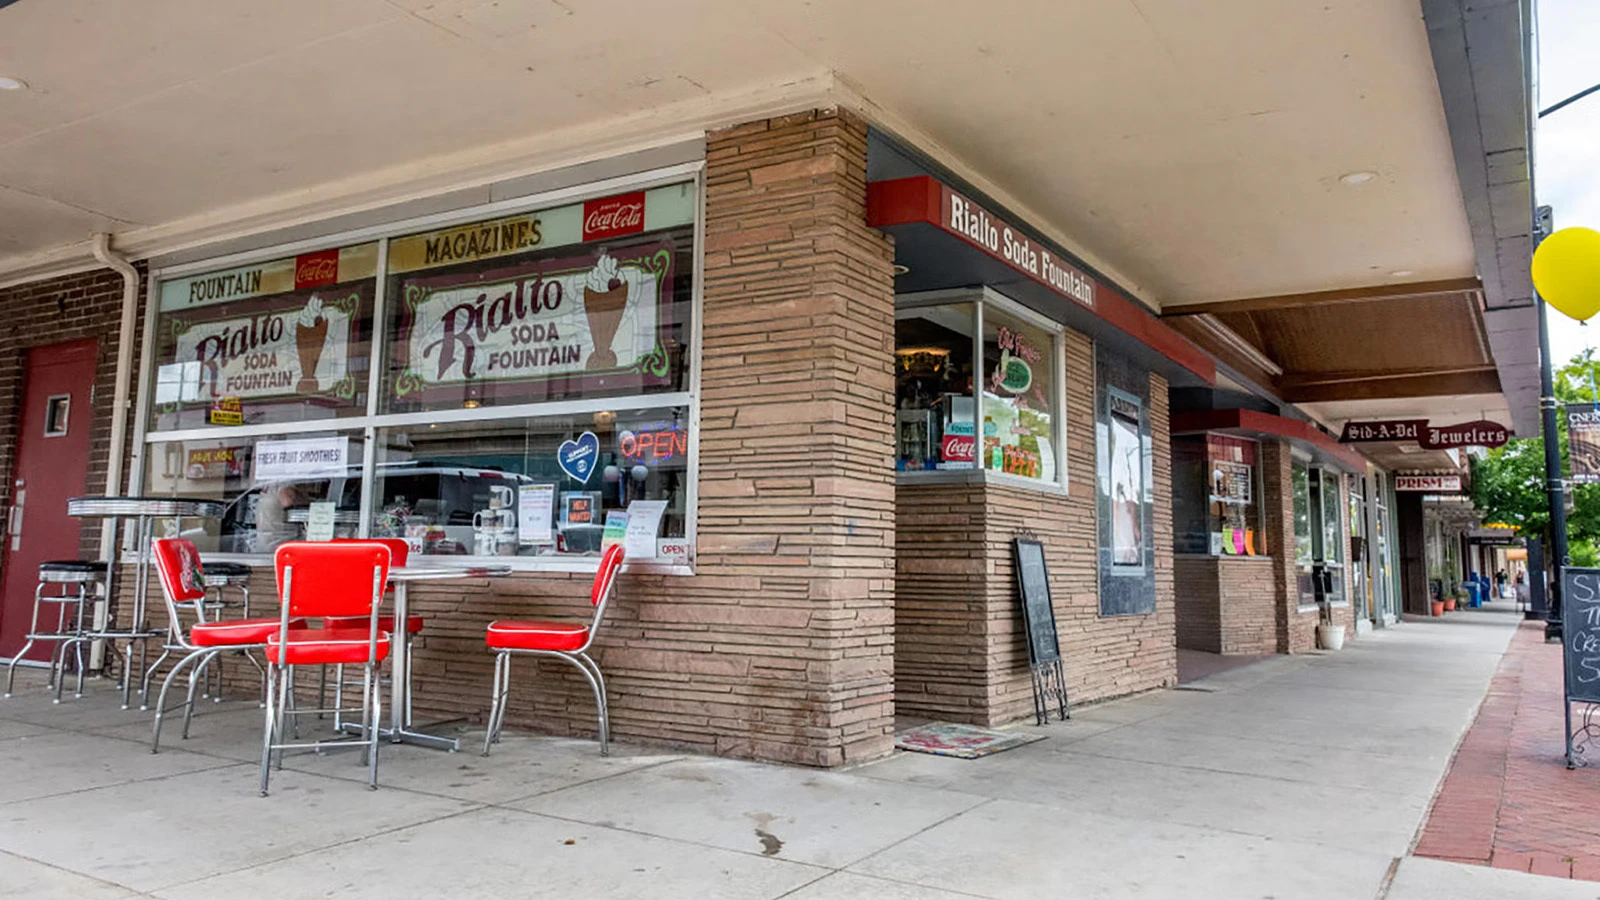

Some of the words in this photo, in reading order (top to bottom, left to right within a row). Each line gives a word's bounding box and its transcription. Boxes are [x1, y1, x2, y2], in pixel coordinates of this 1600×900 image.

[424, 219, 542, 264] MAGAZINES
[951, 194, 998, 252] Rialto
[1003, 227, 1038, 275] Soda
[1042, 251, 1093, 305] Fountain
[189, 269, 262, 303] FOUNTAIN
[423, 273, 563, 381] Rialto
[510, 322, 559, 345] SODA
[194, 314, 284, 397] Rialto
[244, 351, 277, 371] SODA
[487, 344, 581, 371] FOUNTAIN
[226, 371, 293, 392] FOUNTAIN
[621, 429, 688, 457] OPEN
[1348, 424, 1418, 439] Sid-A-Del
[1429, 428, 1505, 444] Jewelers
[258, 452, 277, 465] FRESH
[280, 451, 298, 464] FRUIT
[1397, 477, 1442, 488] PRISM
[661, 545, 685, 555] OPEN
